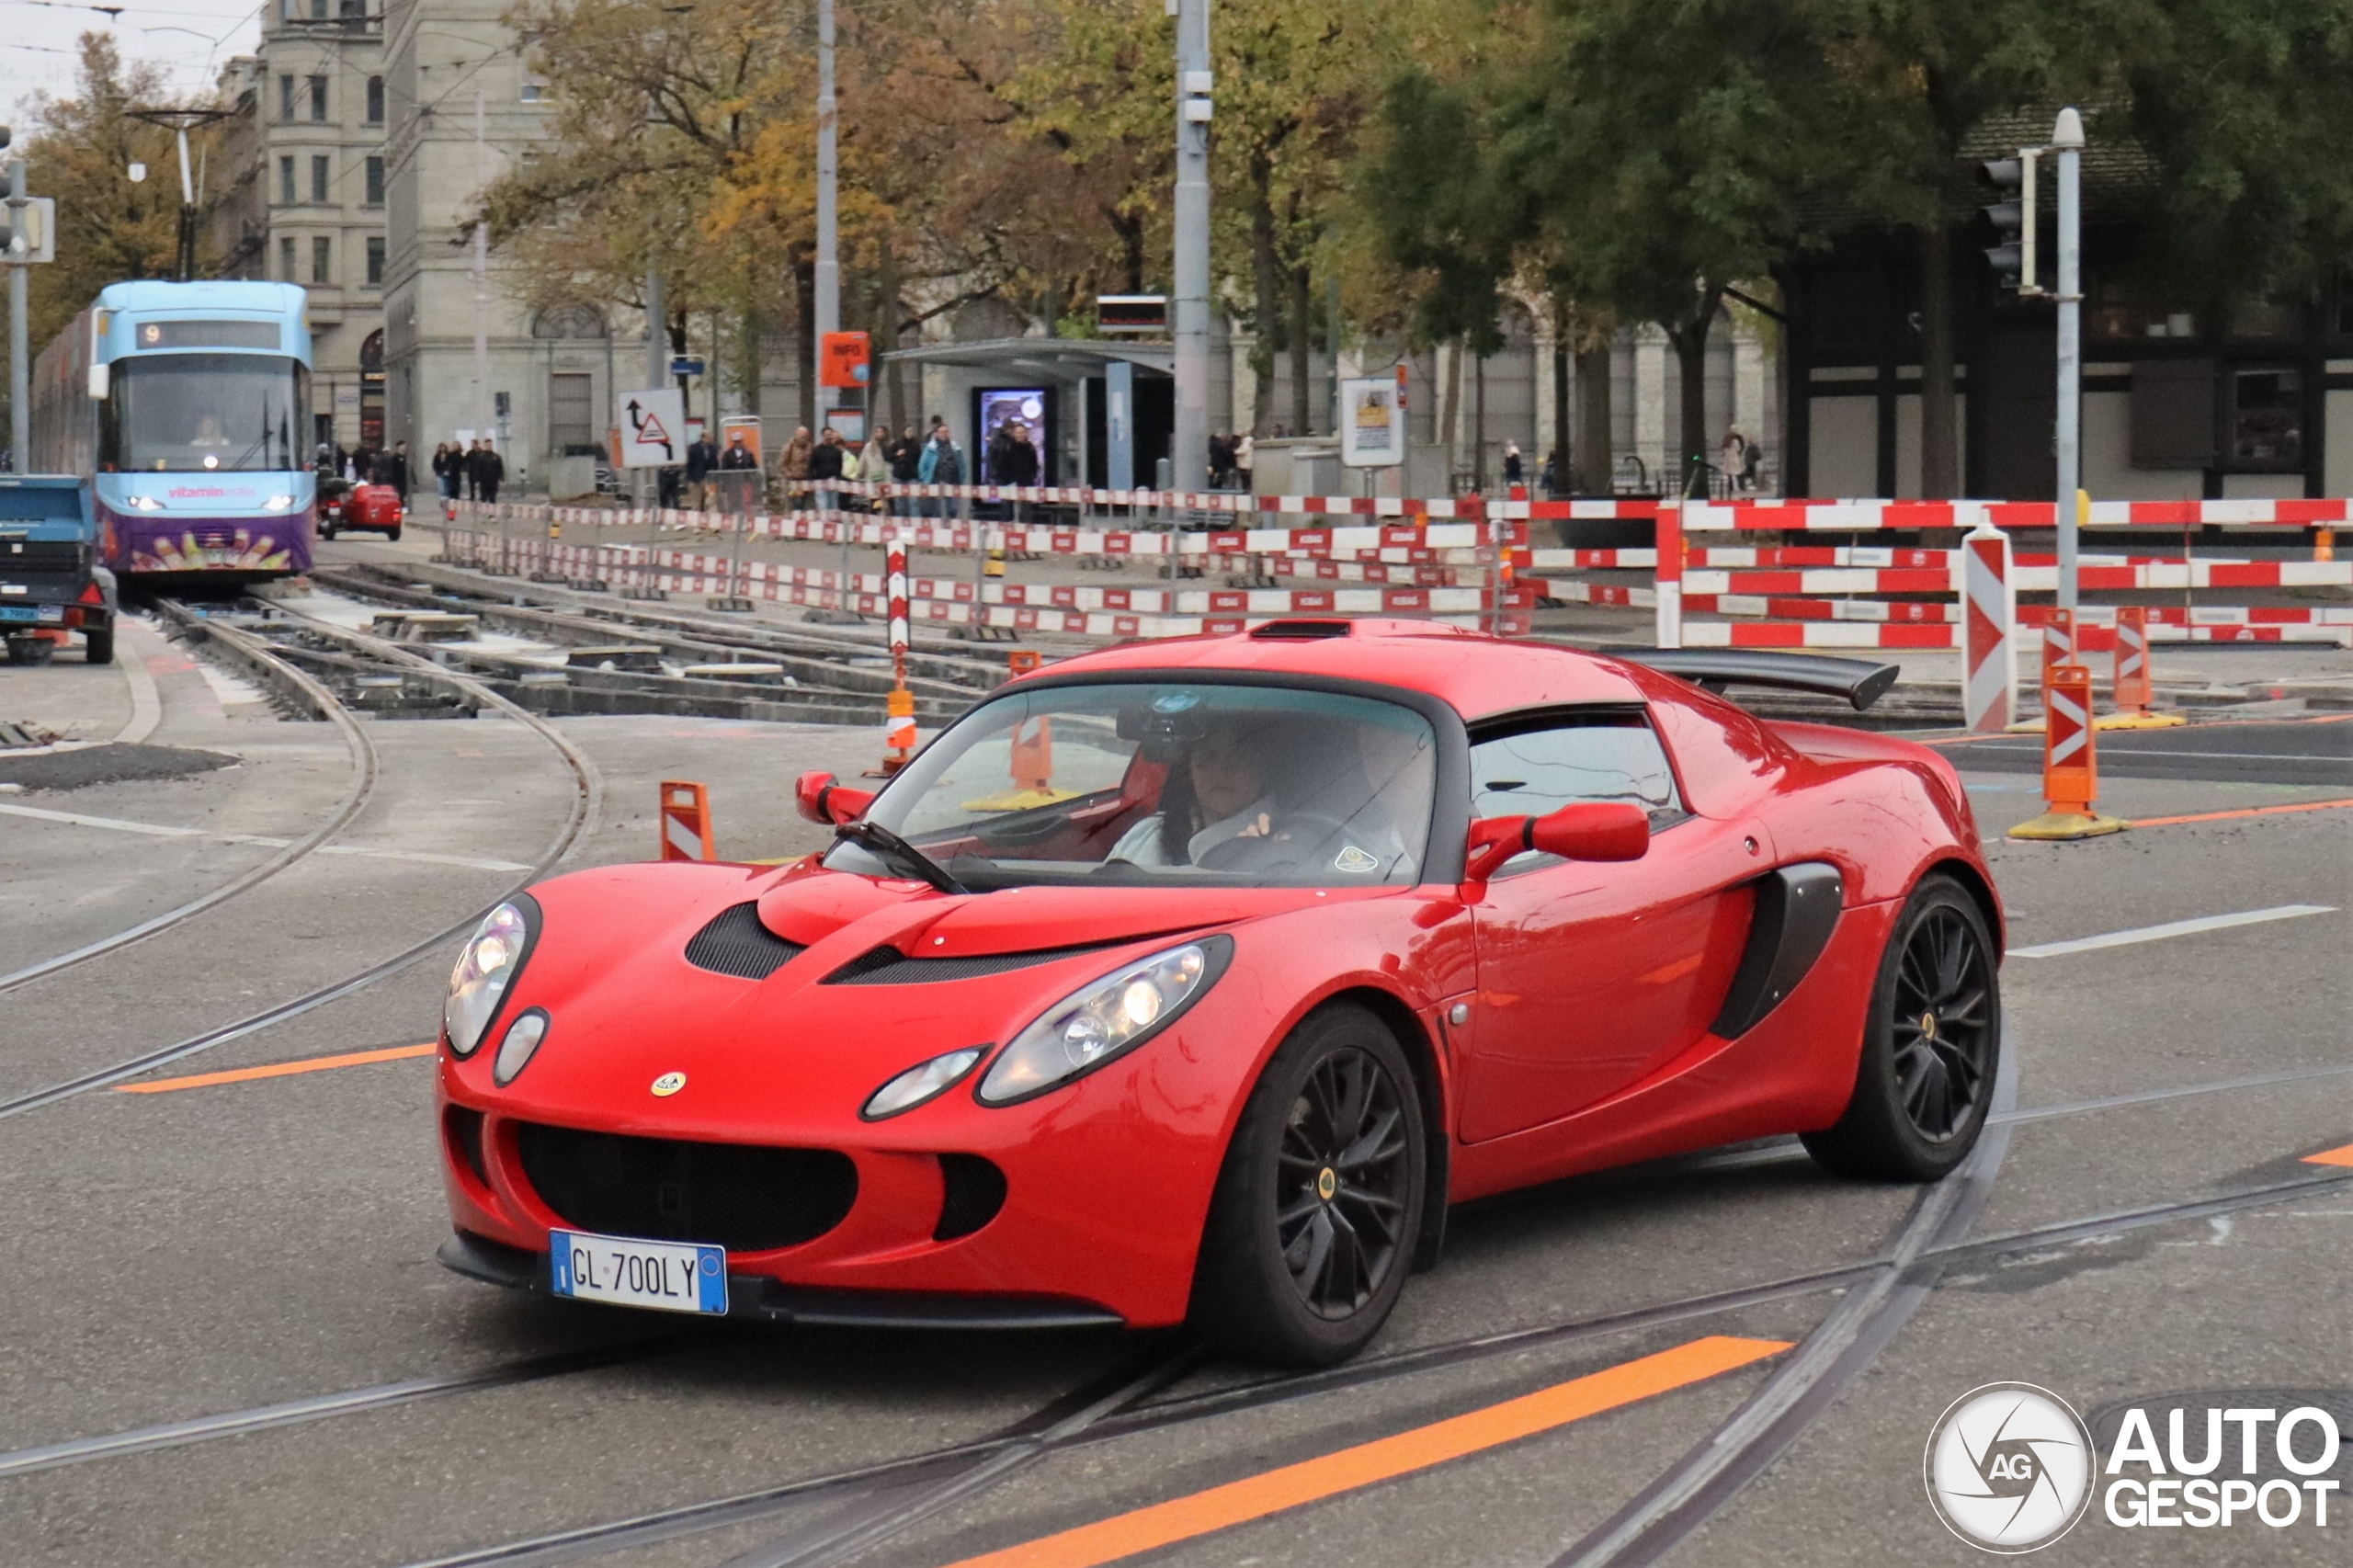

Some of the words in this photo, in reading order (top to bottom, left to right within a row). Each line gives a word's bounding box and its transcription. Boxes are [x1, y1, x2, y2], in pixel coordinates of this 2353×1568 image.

[145, 324, 160, 342] 9
[168, 486, 256, 498] vitamin
[611, 1253, 695, 1297] 700LY
